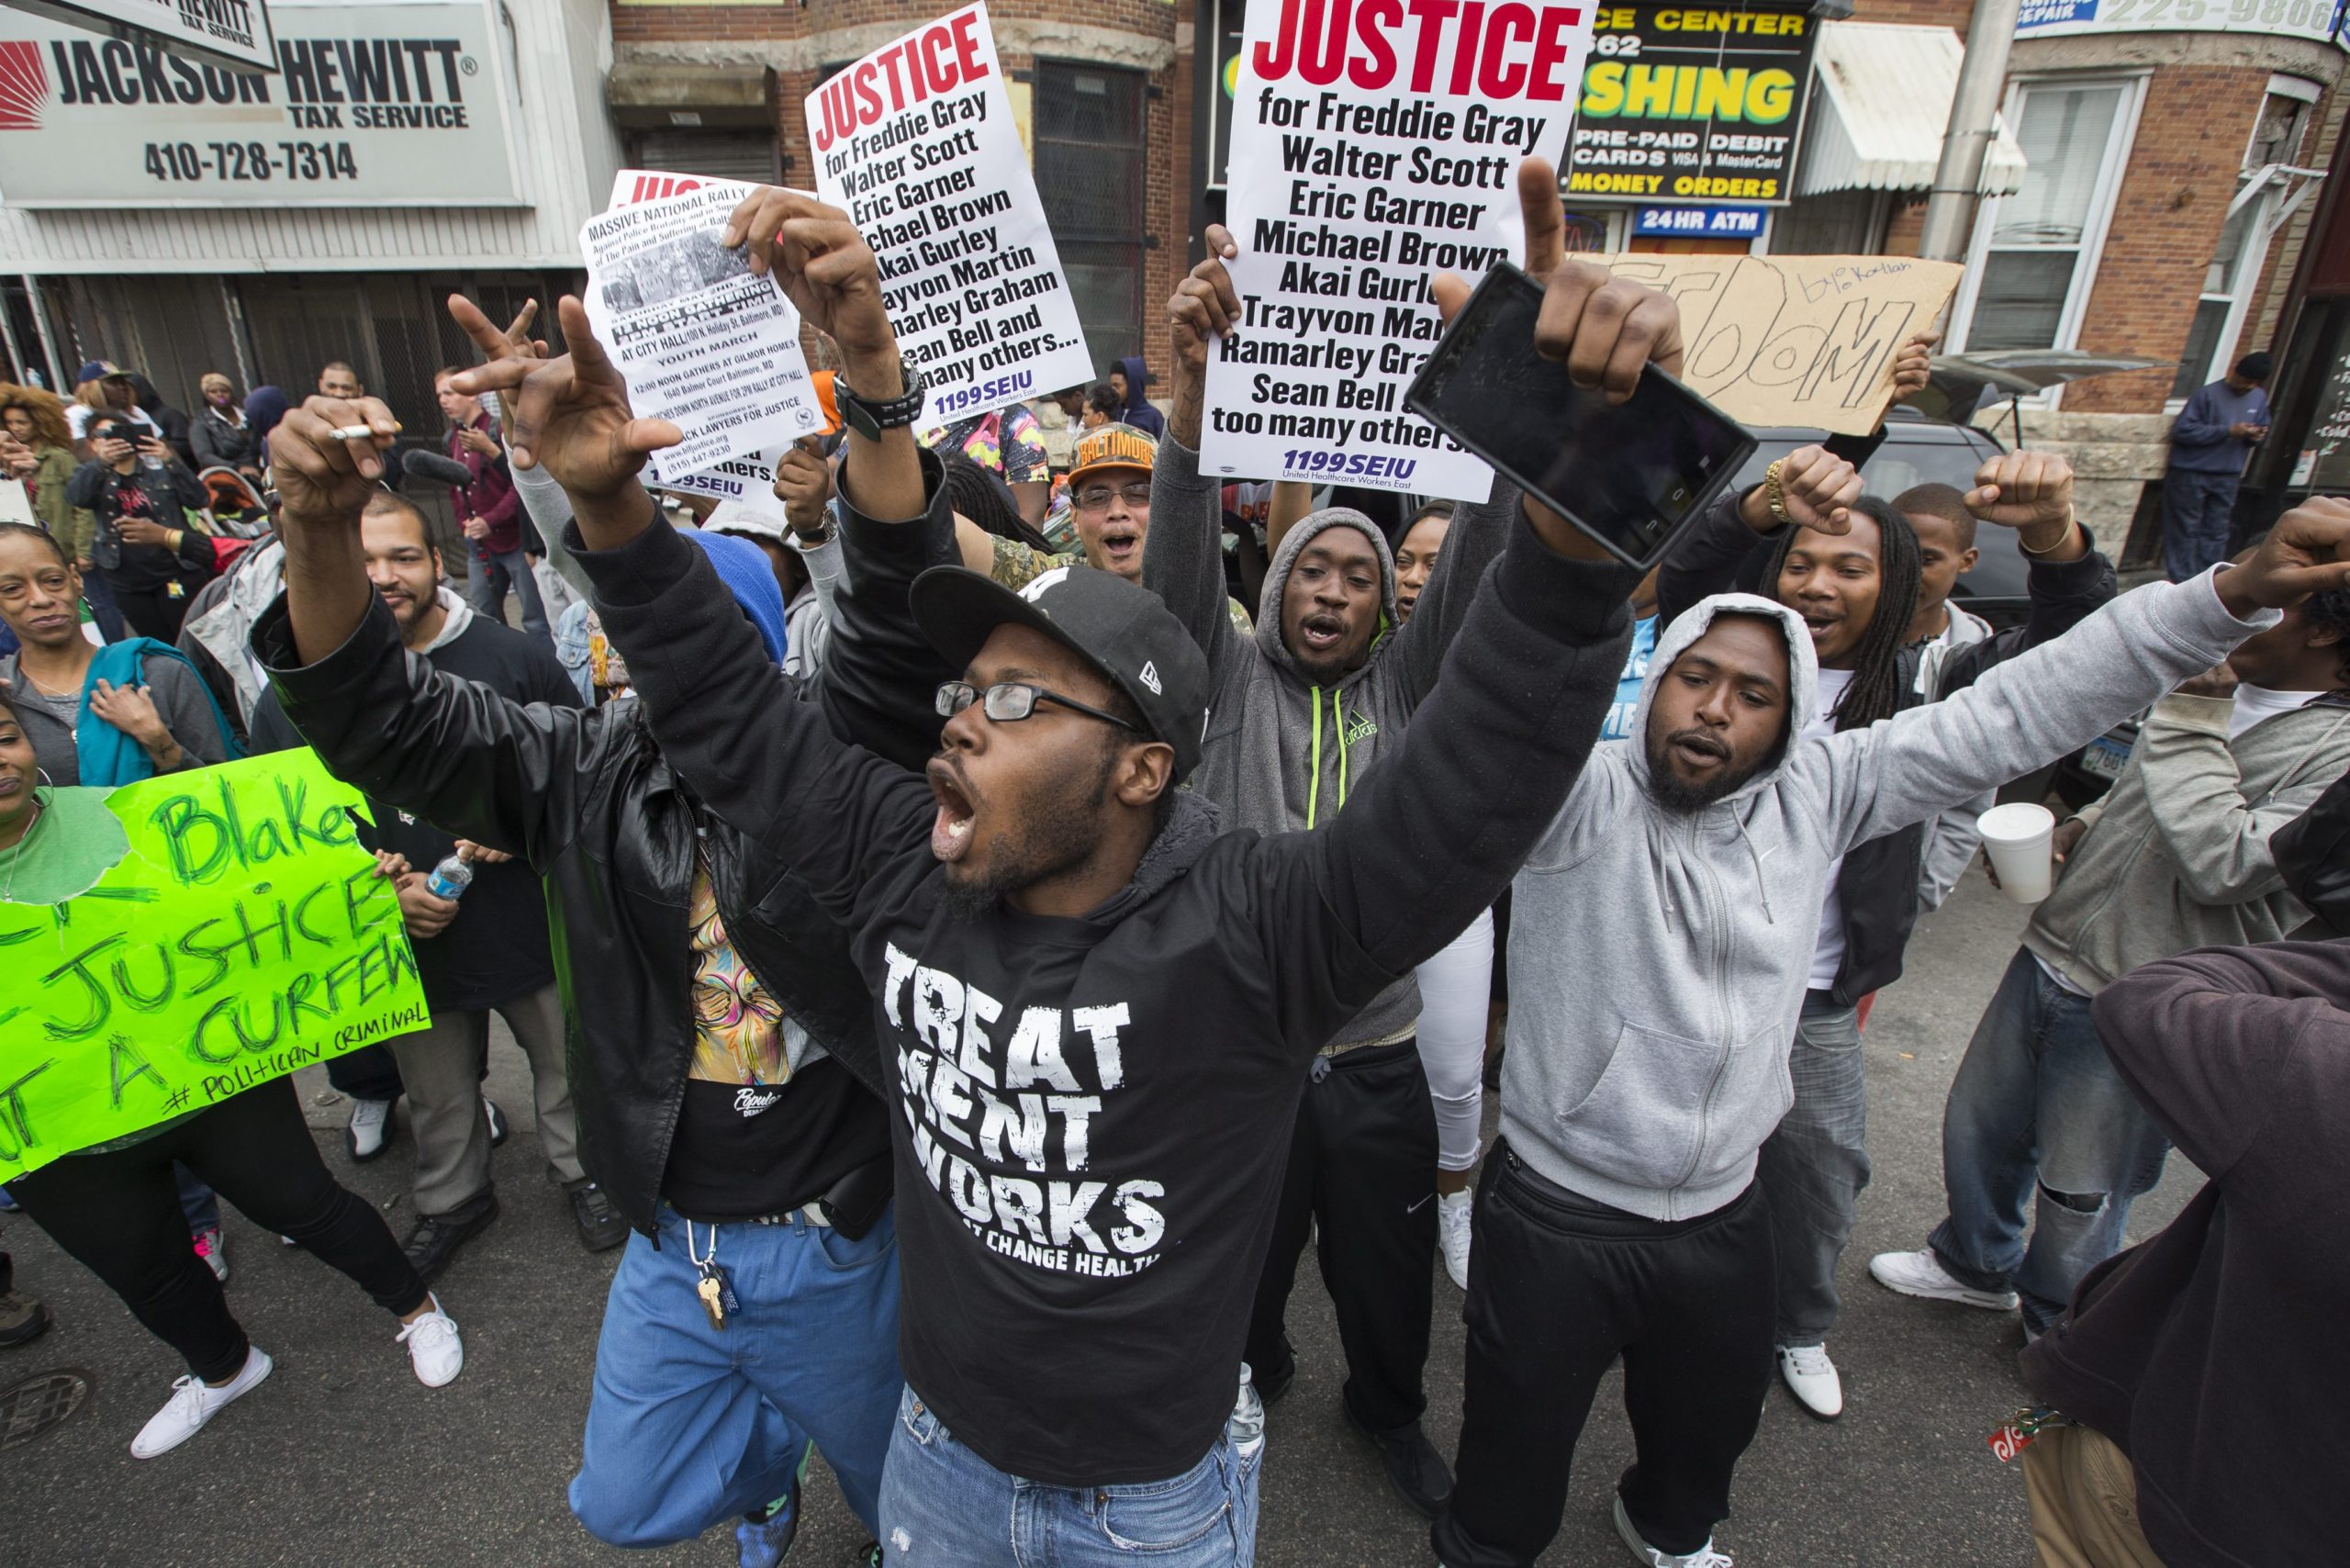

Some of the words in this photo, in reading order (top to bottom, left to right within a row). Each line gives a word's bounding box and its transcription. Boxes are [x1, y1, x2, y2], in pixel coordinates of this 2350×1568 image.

[178, 11, 206, 33] TAX
[207, 20, 257, 50] SERVICE
[1654, 10, 1806, 36] CENTER
[52, 39, 272, 104] JACKSON
[1251, 0, 1581, 101] JUSTICE
[816, 11, 990, 152] JUSTICE
[1577, 61, 1796, 125] SHING
[287, 106, 343, 129] TAX
[353, 106, 469, 129] SERVICE
[825, 147, 851, 180] for
[851, 112, 928, 157] Freddie
[933, 90, 988, 129] Gray
[1259, 87, 1310, 127] for
[1316, 93, 1456, 140] Freddie
[1462, 104, 1546, 156] Gray
[1574, 129, 1699, 149] PRE-PAID
[1709, 134, 1789, 152] DEBIT
[145, 141, 358, 181] 410-728-7314
[841, 154, 906, 200] Walter
[913, 128, 979, 172] Scott
[1281, 134, 1401, 182] Walter
[1407, 147, 1509, 189] Scott
[1572, 149, 1666, 166] CARDS
[1672, 151, 1698, 166] VISA
[1715, 153, 1784, 170] MasterCard
[852, 195, 894, 227] Eric
[897, 165, 976, 214] Garner
[1289, 180, 1355, 221] Eric
[1363, 186, 1486, 231] Garner
[1570, 173, 1663, 194] MONEY
[1673, 176, 1778, 198] ORDERS
[588, 212, 641, 242] MASSIVE
[643, 196, 706, 223] NATIONAL
[708, 187, 746, 203] RALLY
[593, 236, 622, 255] Against
[622, 227, 649, 244] Police
[650, 217, 687, 232] Brutality
[688, 210, 705, 222] and
[861, 207, 931, 252] chael
[935, 188, 1012, 238] Brown
[1710, 212, 1759, 230] ATM
[595, 256, 605, 267] of
[605, 250, 621, 263] The
[621, 241, 641, 255] Pain
[642, 236, 657, 248] and
[659, 223, 698, 242] Suffering
[699, 220, 708, 229] of
[923, 224, 998, 265] Gurley
[1253, 218, 1393, 263] Michael
[1398, 232, 1508, 274] Brown
[679, 292, 706, 305] MAY
[883, 274, 952, 312] ayvon
[953, 243, 1035, 287] Martin
[967, 270, 1058, 317] Graham
[1279, 262, 1349, 298] Akai
[1358, 266, 1439, 306] Gurl
[636, 308, 681, 330] NOON
[684, 281, 773, 315] GATHERING
[663, 308, 723, 331] START
[728, 293, 777, 313] TIME
[1243, 295, 1376, 338] Trayvon
[1382, 307, 1444, 342] Mar
[621, 348, 634, 363] AT
[635, 342, 658, 358] CITY
[707, 321, 732, 337] Holiday
[742, 310, 772, 328] Baltimore,
[773, 305, 785, 318] MD)
[658, 348, 706, 365] YOUTH
[710, 332, 758, 353] MARCH
[903, 339, 946, 366] ean
[950, 317, 995, 357] Bell
[998, 303, 1043, 340] and
[980, 336, 1079, 371] others...
[1220, 332, 1375, 379] Ramarley
[634, 381, 656, 395] 12:00
[657, 372, 682, 386] NOON
[683, 363, 722, 380] GATHERS
[722, 358, 733, 367] AT
[734, 349, 767, 364] GILMOR
[767, 340, 796, 354] HOMES
[664, 388, 681, 400] 1640
[682, 380, 706, 395] Balmor
[707, 375, 726, 387] Court
[727, 365, 762, 382] Baltimore,
[763, 360, 774, 369] MD
[674, 401, 692, 418] DOWN
[690, 398, 709, 410] NORTH
[709, 392, 731, 406] AVENUE
[730, 387, 742, 399] FOR
[741, 384, 754, 396] 2PM
[753, 380, 769, 392] RALLY
[769, 377, 777, 386] AT
[776, 374, 789, 385] CITY
[789, 369, 803, 381] HALL
[934, 370, 1032, 415] 1199SEIU
[939, 411, 961, 422] United
[962, 401, 996, 416] Healthcare
[995, 393, 1023, 405] Workers
[1024, 387, 1037, 397] East
[1251, 374, 1329, 408] Sean
[1336, 379, 1396, 412] Bell
[699, 415, 743, 436] LAWYERS
[744, 409, 763, 423] FOR
[765, 397, 800, 416] JUSTICE
[1212, 408, 1262, 435] too
[1269, 412, 1355, 447] many
[1079, 431, 1154, 467] BALTIMORE
[1284, 450, 1416, 479] 1199SEIU
[1282, 470, 1309, 479] United
[1311, 472, 1355, 483] Healthcare
[1358, 476, 1392, 487] Workers
[1393, 480, 1411, 488] East
[149, 774, 358, 887] Blake
[107, 1030, 168, 1112] A
[188, 921, 420, 1065] CURFEW
[884, 941, 1130, 1092] TREAT
[898, 1043, 1102, 1172] MENT
[903, 1097, 1165, 1254] WORKS
[987, 1230, 1069, 1271] CHANGE
